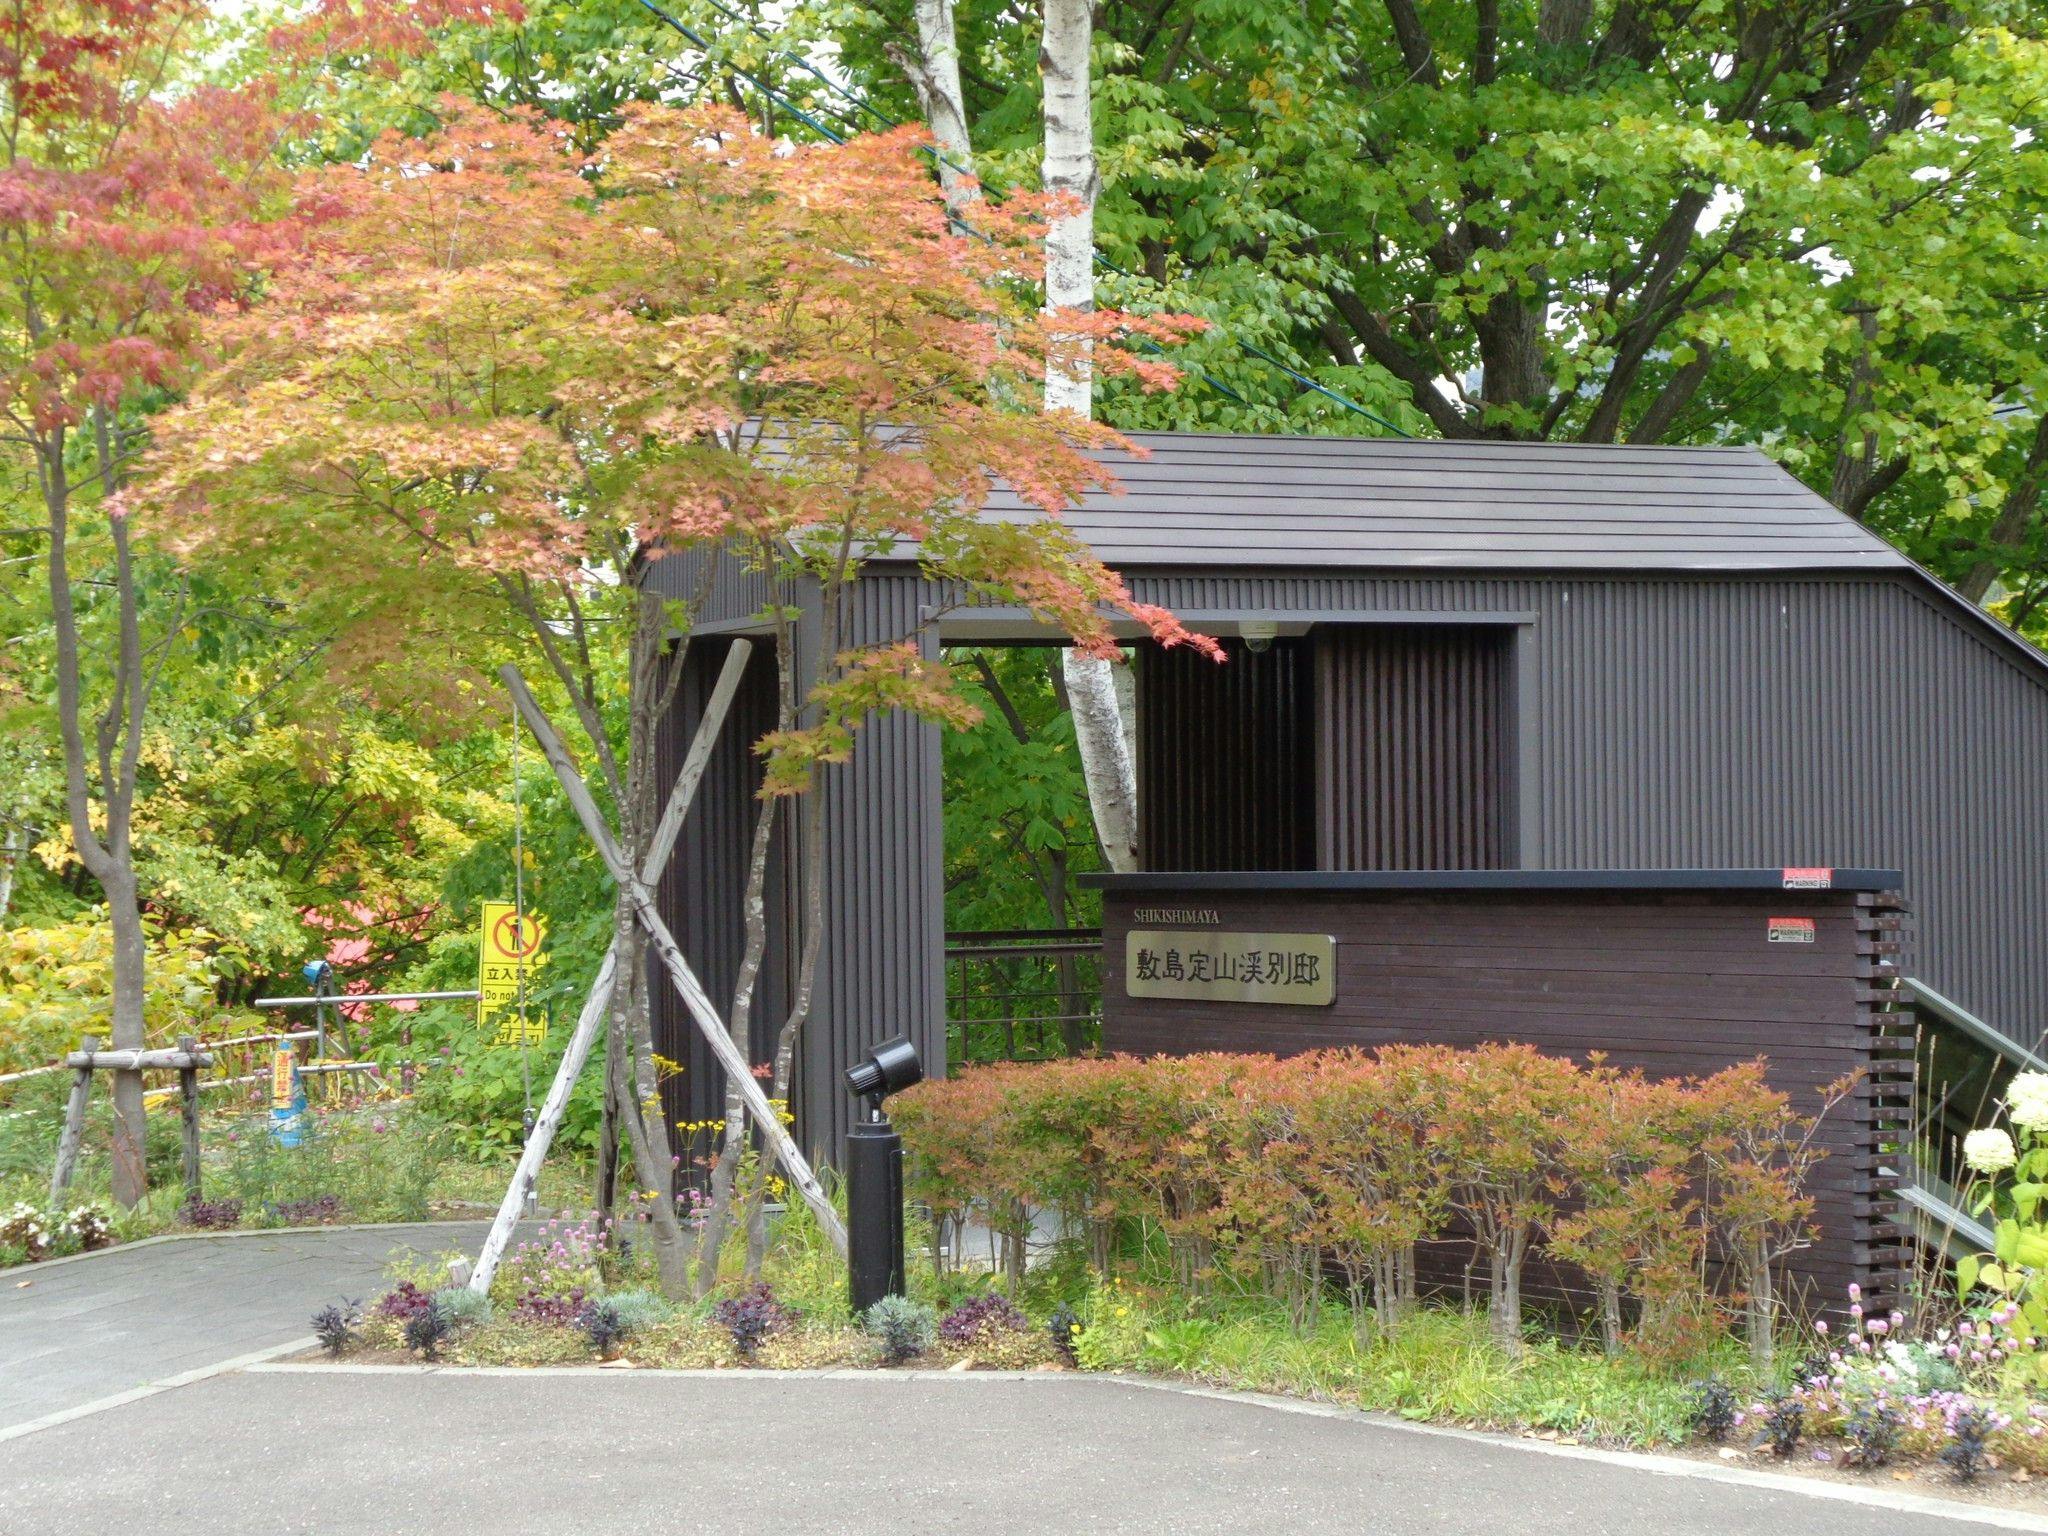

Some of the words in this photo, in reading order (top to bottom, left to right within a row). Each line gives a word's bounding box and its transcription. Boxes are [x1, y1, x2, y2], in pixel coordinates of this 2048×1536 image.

[1134, 908, 1219, 924] SHIKISHIMAYA
[1135, 948, 1320, 986] 敷島定山渓別邸
[485, 989, 497, 1000] Do
